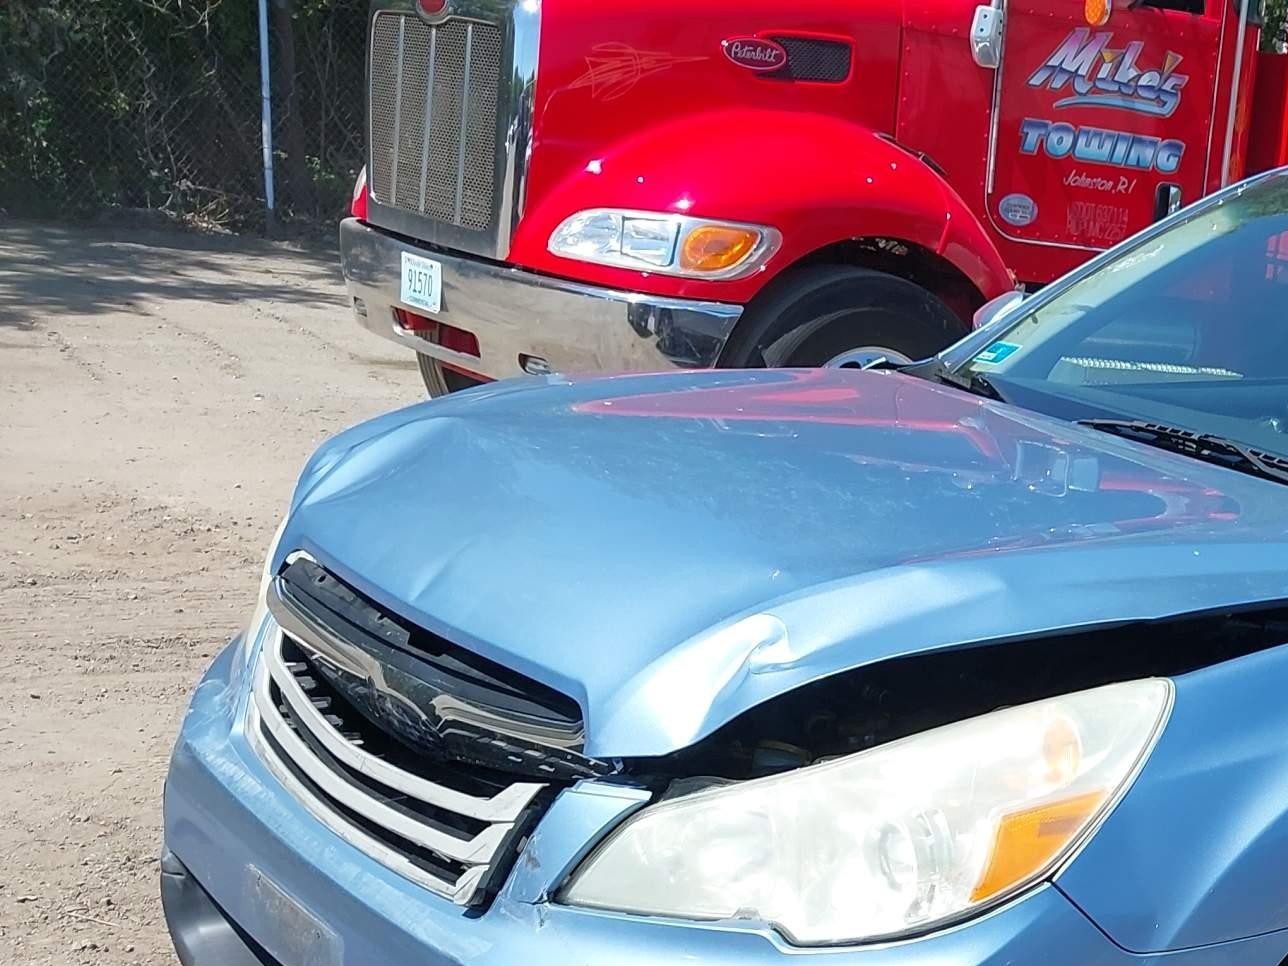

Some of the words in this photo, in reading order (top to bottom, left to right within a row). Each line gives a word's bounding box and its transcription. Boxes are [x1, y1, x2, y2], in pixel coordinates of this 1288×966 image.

[731, 41, 780, 62] Peterbilt
[1020, 117, 1186, 175] TOWING
[408, 268, 433, 297] 91570
